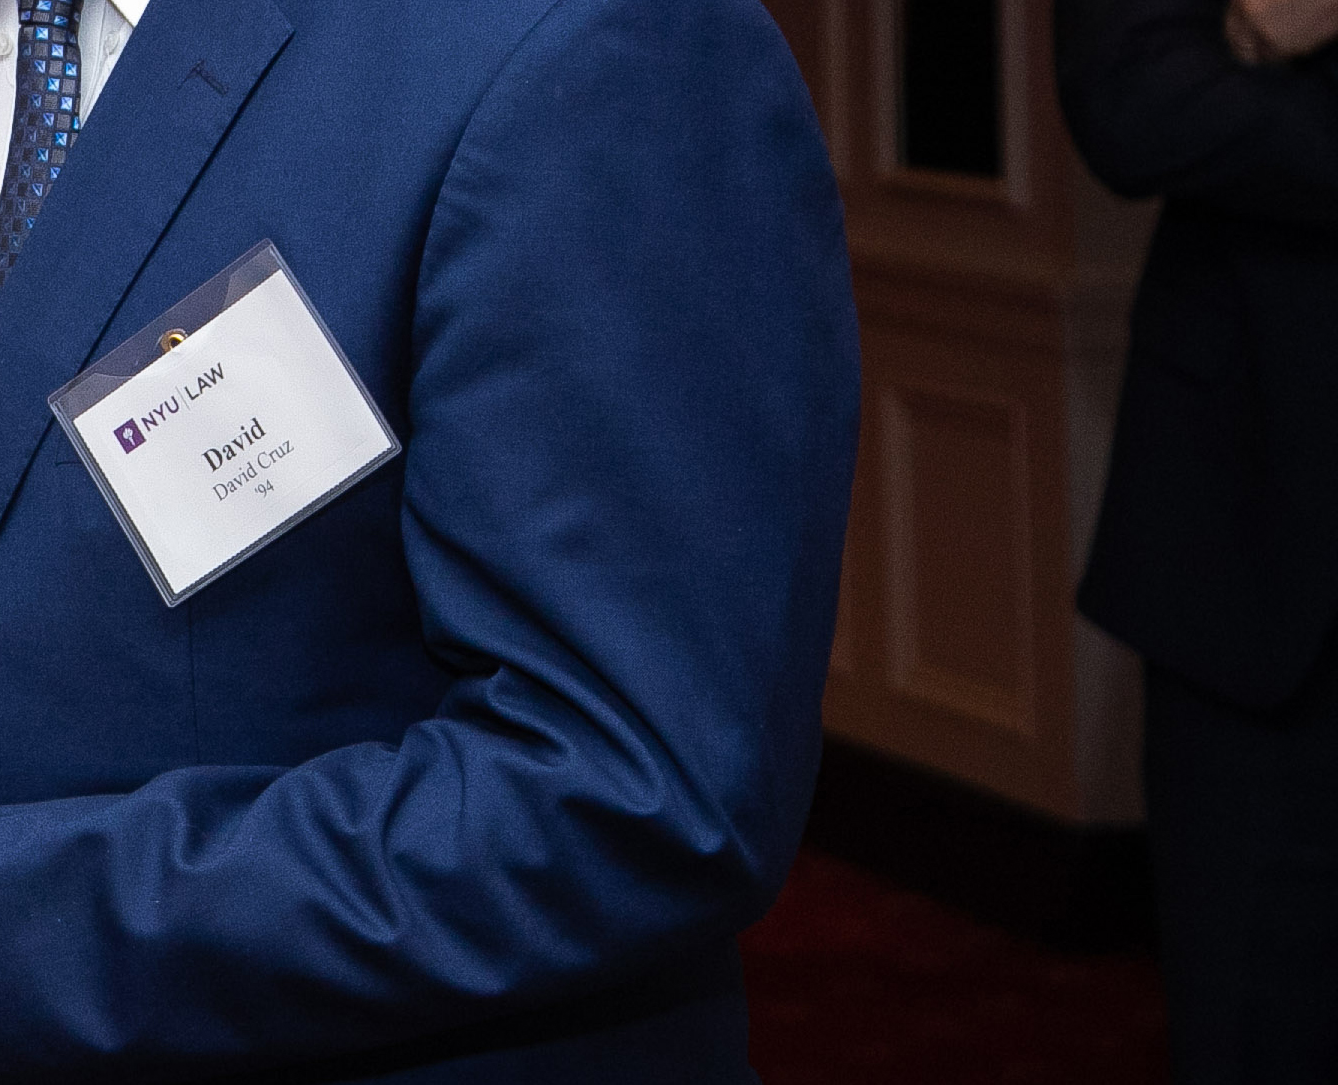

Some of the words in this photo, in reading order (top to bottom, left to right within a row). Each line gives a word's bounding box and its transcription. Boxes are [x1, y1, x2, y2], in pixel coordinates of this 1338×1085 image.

[141, 396, 180, 432] NYU
[184, 362, 225, 401] LAW
[201, 417, 266, 472] David
[212, 460, 259, 503] David
[256, 437, 296, 471] Cruz
[253, 478, 276, 500] '94
